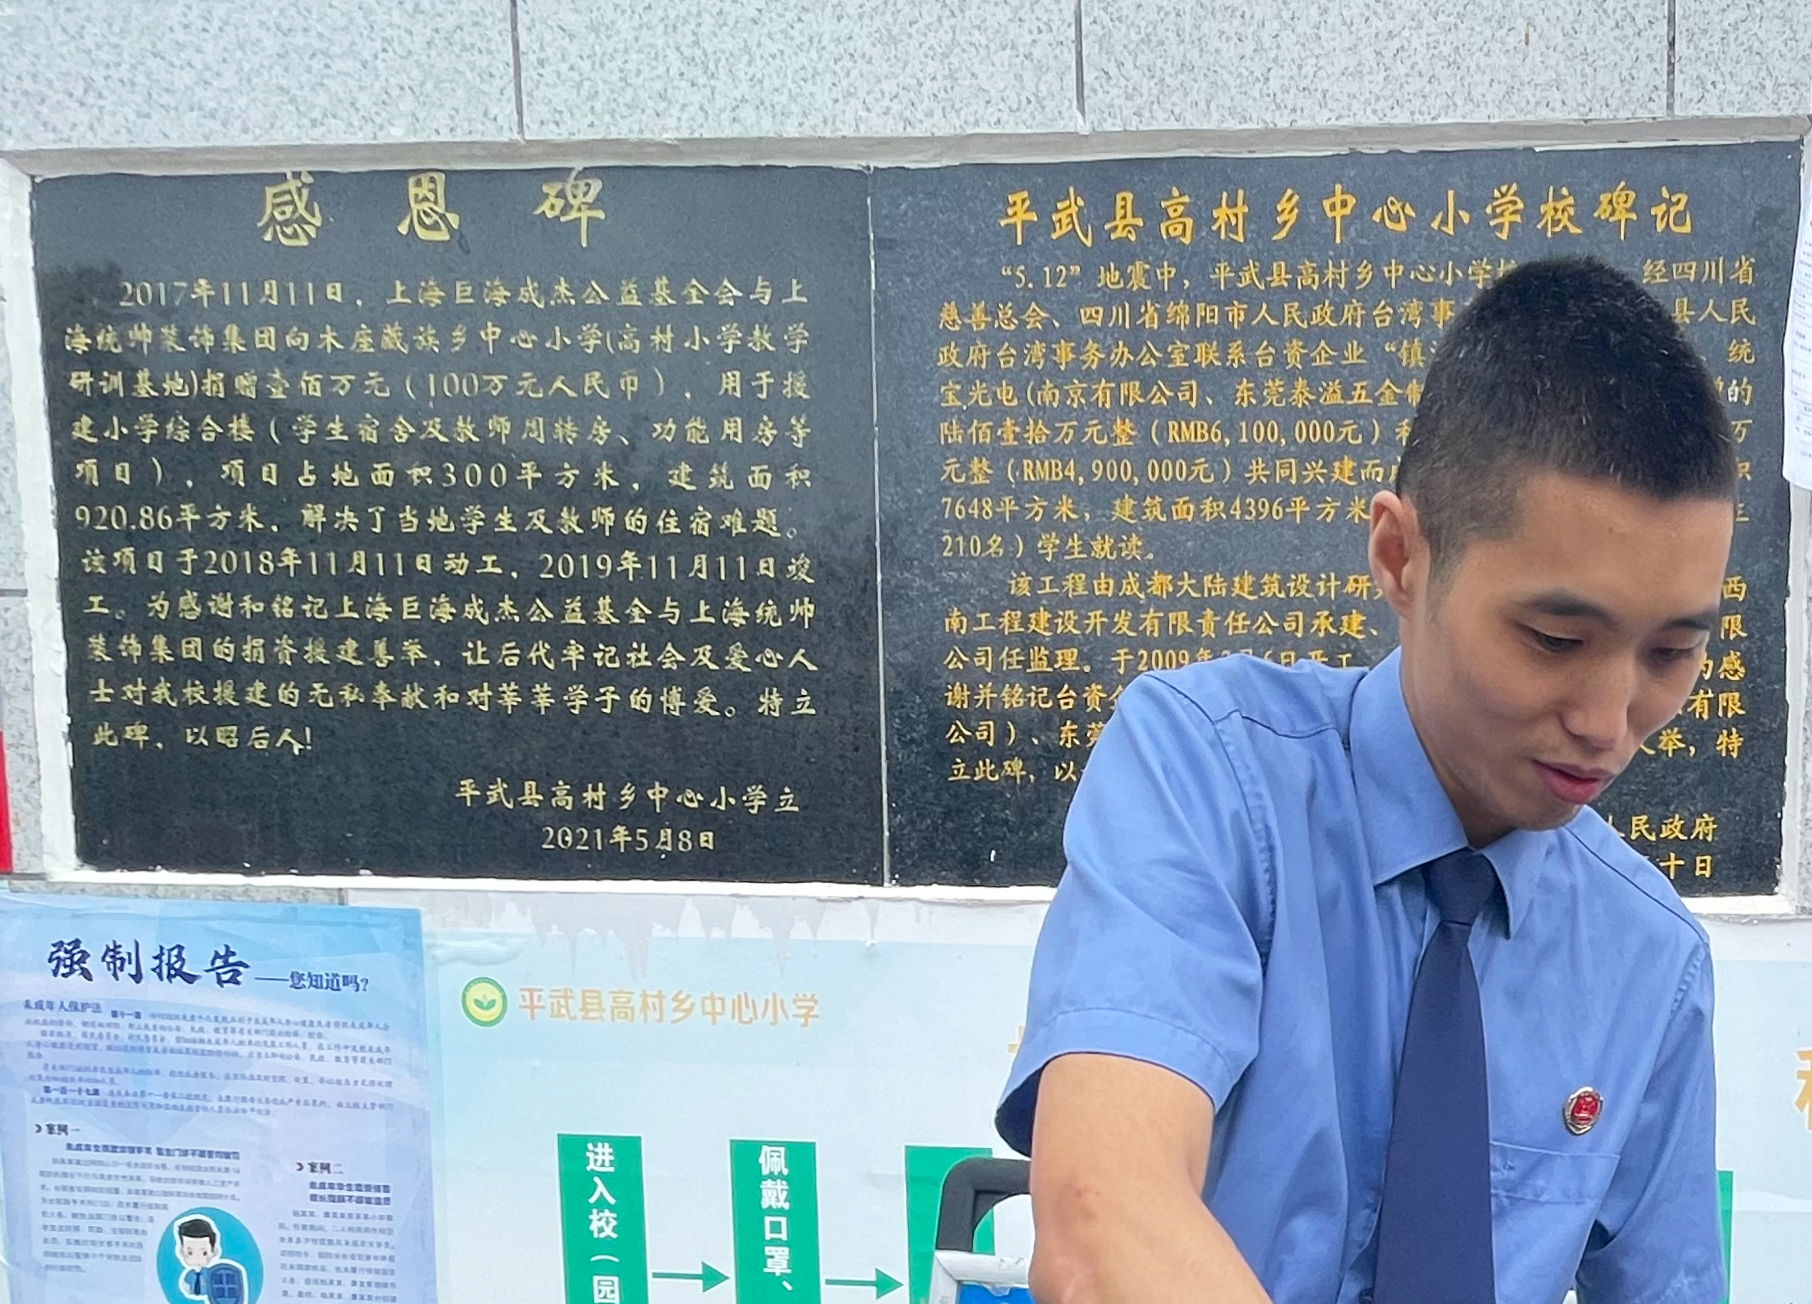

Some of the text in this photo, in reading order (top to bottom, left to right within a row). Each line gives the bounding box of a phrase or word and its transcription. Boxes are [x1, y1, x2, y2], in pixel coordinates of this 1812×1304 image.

[256, 170, 606, 248] 感恩碑
[998, 181, 1693, 247] 平武县高村乡中心小学校碑记
[1642, 255, 1756, 286] 经四川省
[937, 297, 1474, 333] 慈善总会、四川省绵阳市人民政府台湾事
[1727, 338, 1756, 365] 统
[1009, 570, 1384, 601] 该工程由成都大陆建筑设计研
[454, 777, 801, 815] 平武县高村乡中心小学立
[541, 823, 717, 854] 2021年5月8日
[46, 937, 252, 988] 强制报告
[517, 986, 821, 1028] 平武县高村乡中心小学
